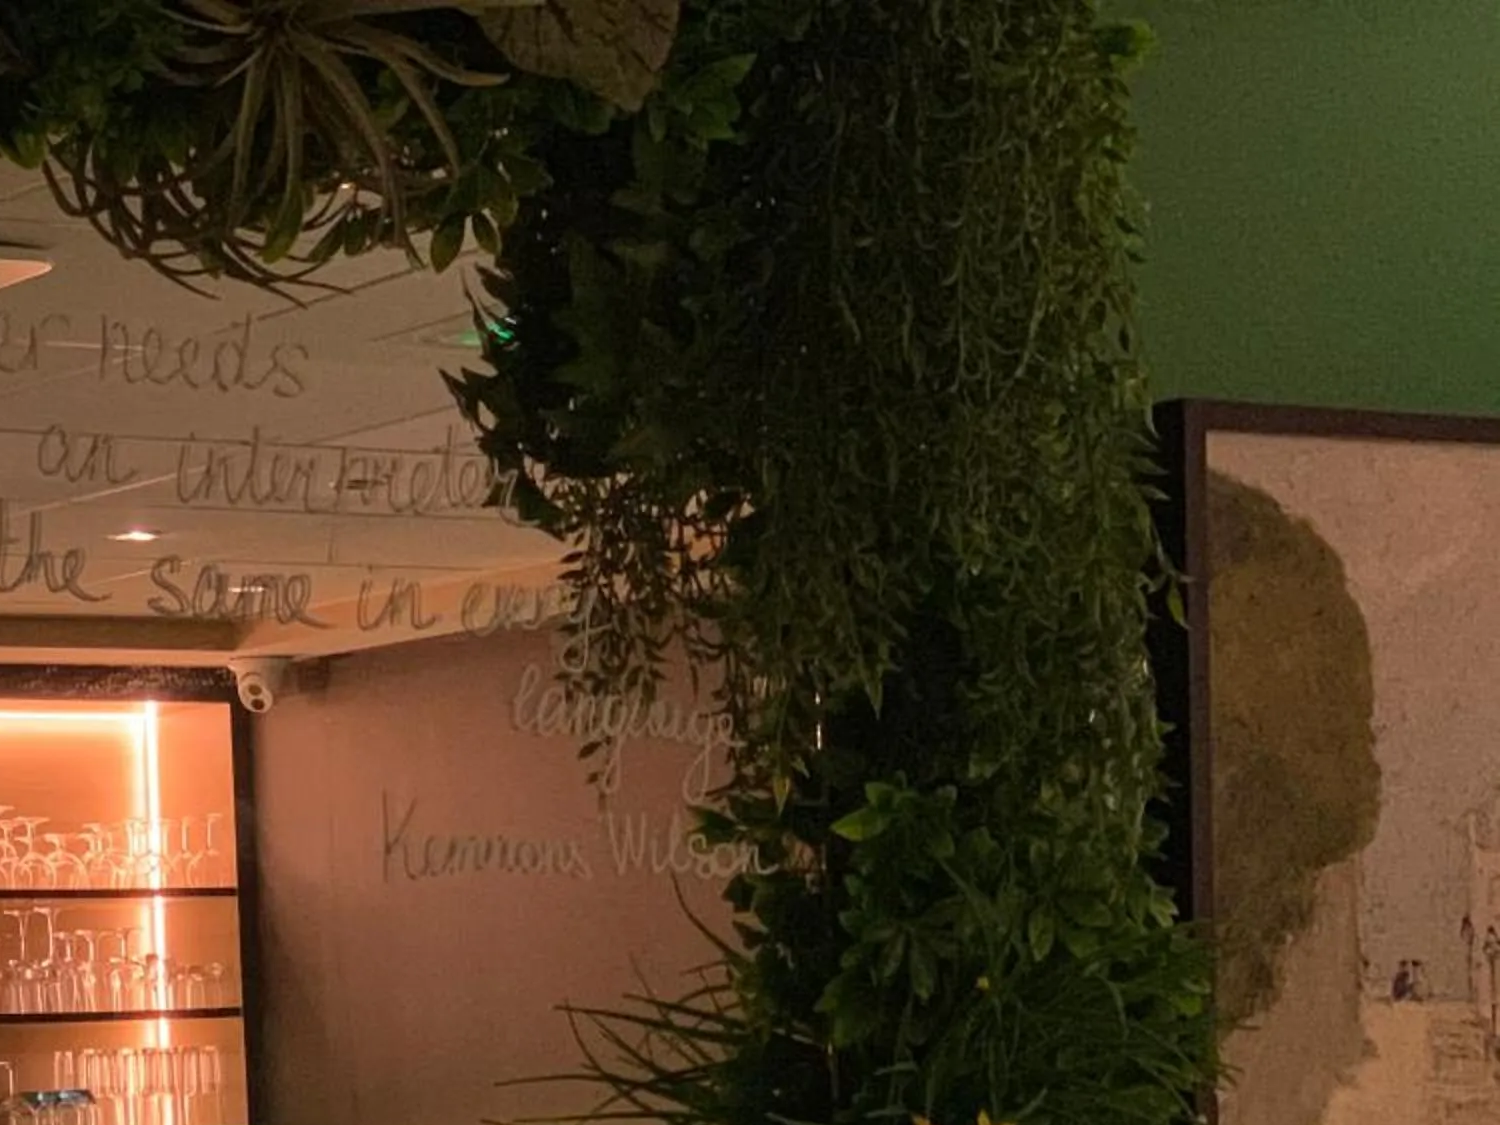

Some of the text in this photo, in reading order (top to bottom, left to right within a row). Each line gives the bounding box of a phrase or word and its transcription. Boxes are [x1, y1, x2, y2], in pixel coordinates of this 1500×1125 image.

[98, 310, 310, 400] needs
[36, 423, 140, 484] an
[356, 563, 443, 631] in
[510, 662, 747, 806] language
[606, 803, 780, 880] Wilson
